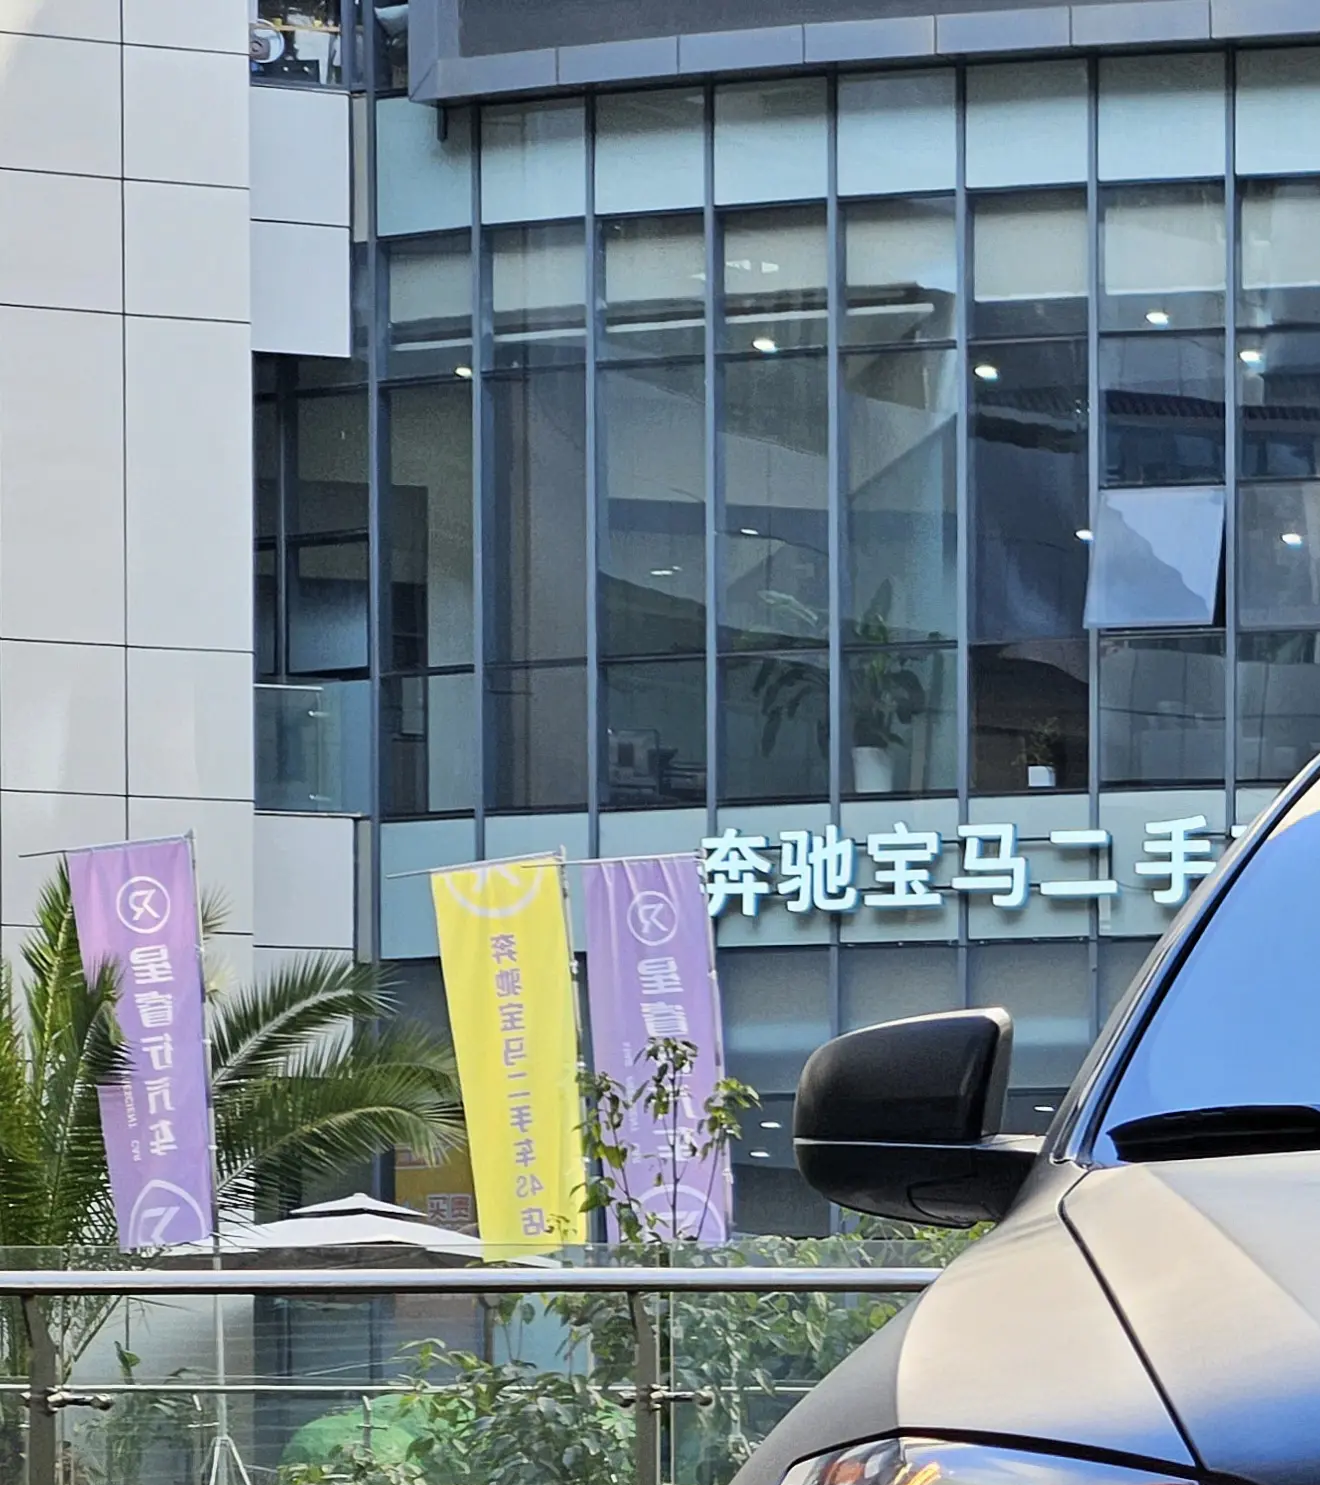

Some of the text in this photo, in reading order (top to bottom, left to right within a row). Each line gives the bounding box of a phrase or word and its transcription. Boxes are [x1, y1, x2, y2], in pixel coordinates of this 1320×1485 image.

[700, 815, 1248, 917] 奔驰宝马二手
